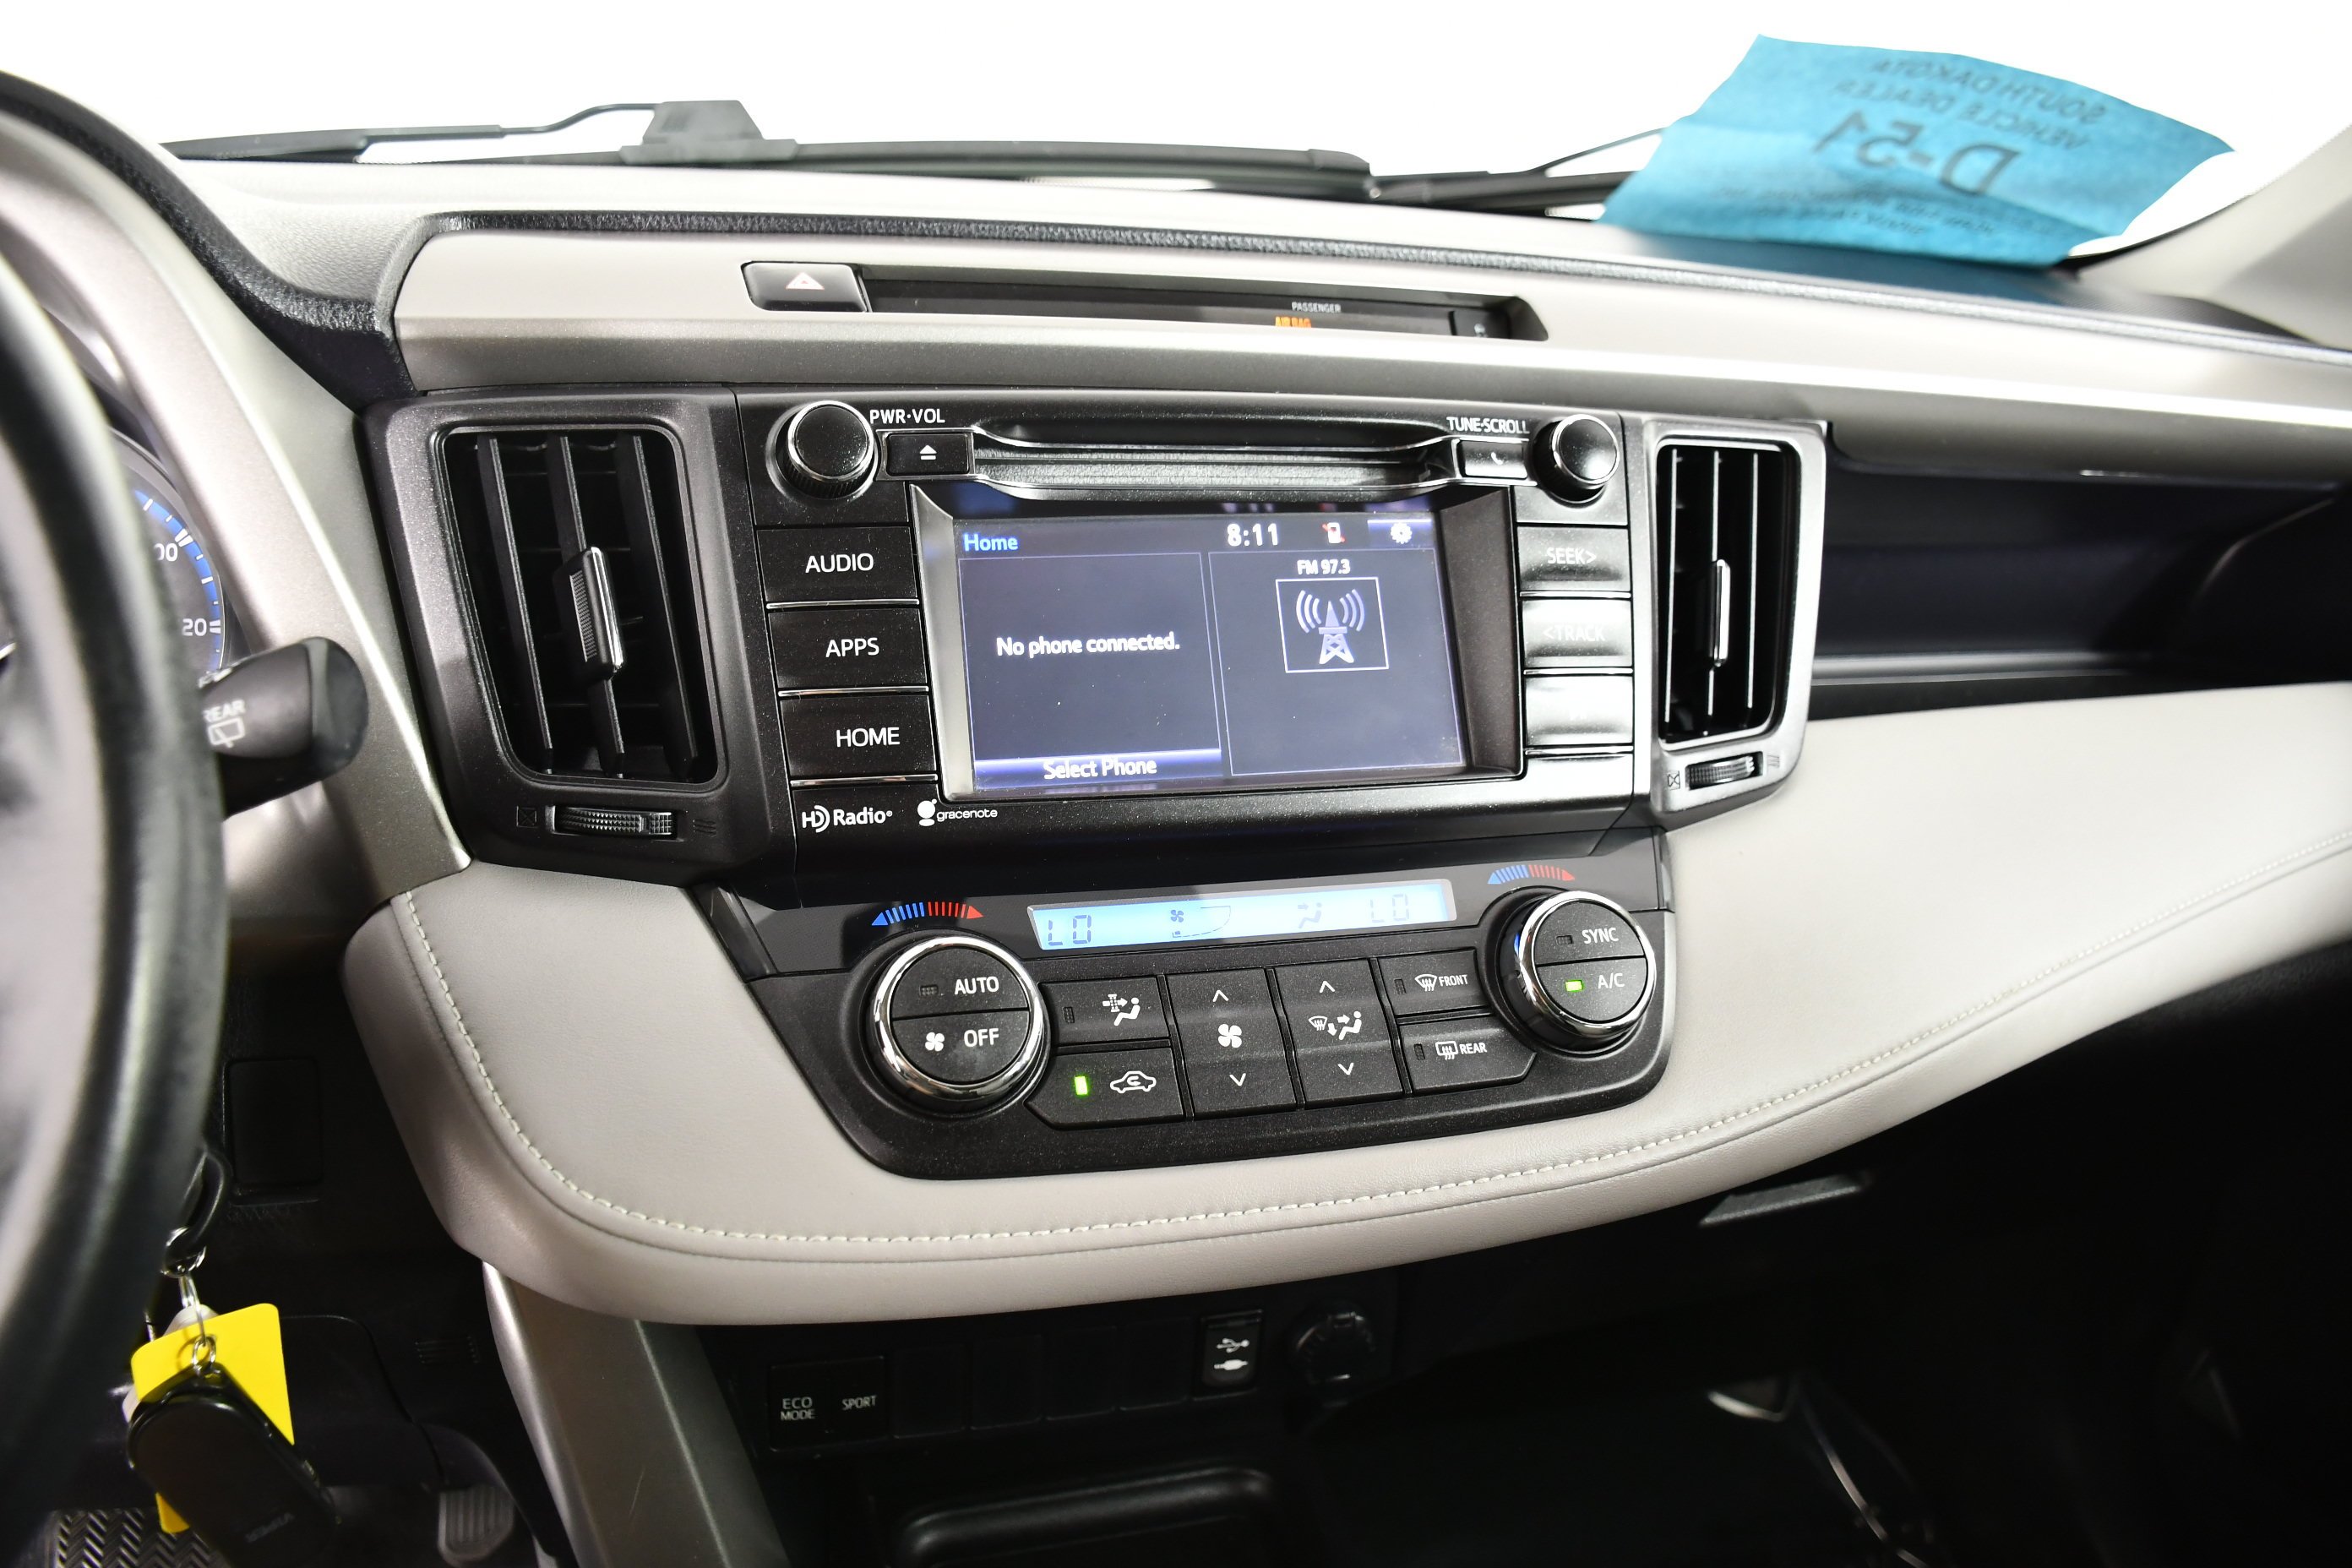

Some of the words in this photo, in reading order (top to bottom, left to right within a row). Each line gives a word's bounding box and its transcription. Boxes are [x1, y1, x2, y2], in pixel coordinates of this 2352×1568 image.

[1291, 302, 1342, 313] PASSENGER
[963, 532, 1020, 553] Home
[1227, 522, 1280, 547] 8:11
[804, 553, 875, 574] AUDIO
[1296, 559, 1320, 576] FM
[1320, 558, 1352, 575] 97.3
[181, 618, 208, 637] 20
[825, 636, 880, 659] APPS
[996, 636, 1026, 657] No
[1028, 634, 1084, 660] phone
[1086, 630, 1181, 655] connected.
[835, 727, 901, 748] HOME
[1043, 759, 1099, 780] Select
[1102, 756, 1158, 776] Phone
[935, 807, 999, 824] gracenote
[1581, 926, 1620, 945] SYNC
[953, 976, 1000, 996] AUTO
[1438, 972, 1469, 988] FRONT
[1597, 972, 1626, 990] A/C
[962, 1027, 1000, 1048] OFF
[1459, 1042, 1488, 1056] REAR
[781, 1396, 813, 1410] ECO
[841, 1395, 877, 1411] SPORT
[780, 1409, 815, 1421] MODE
